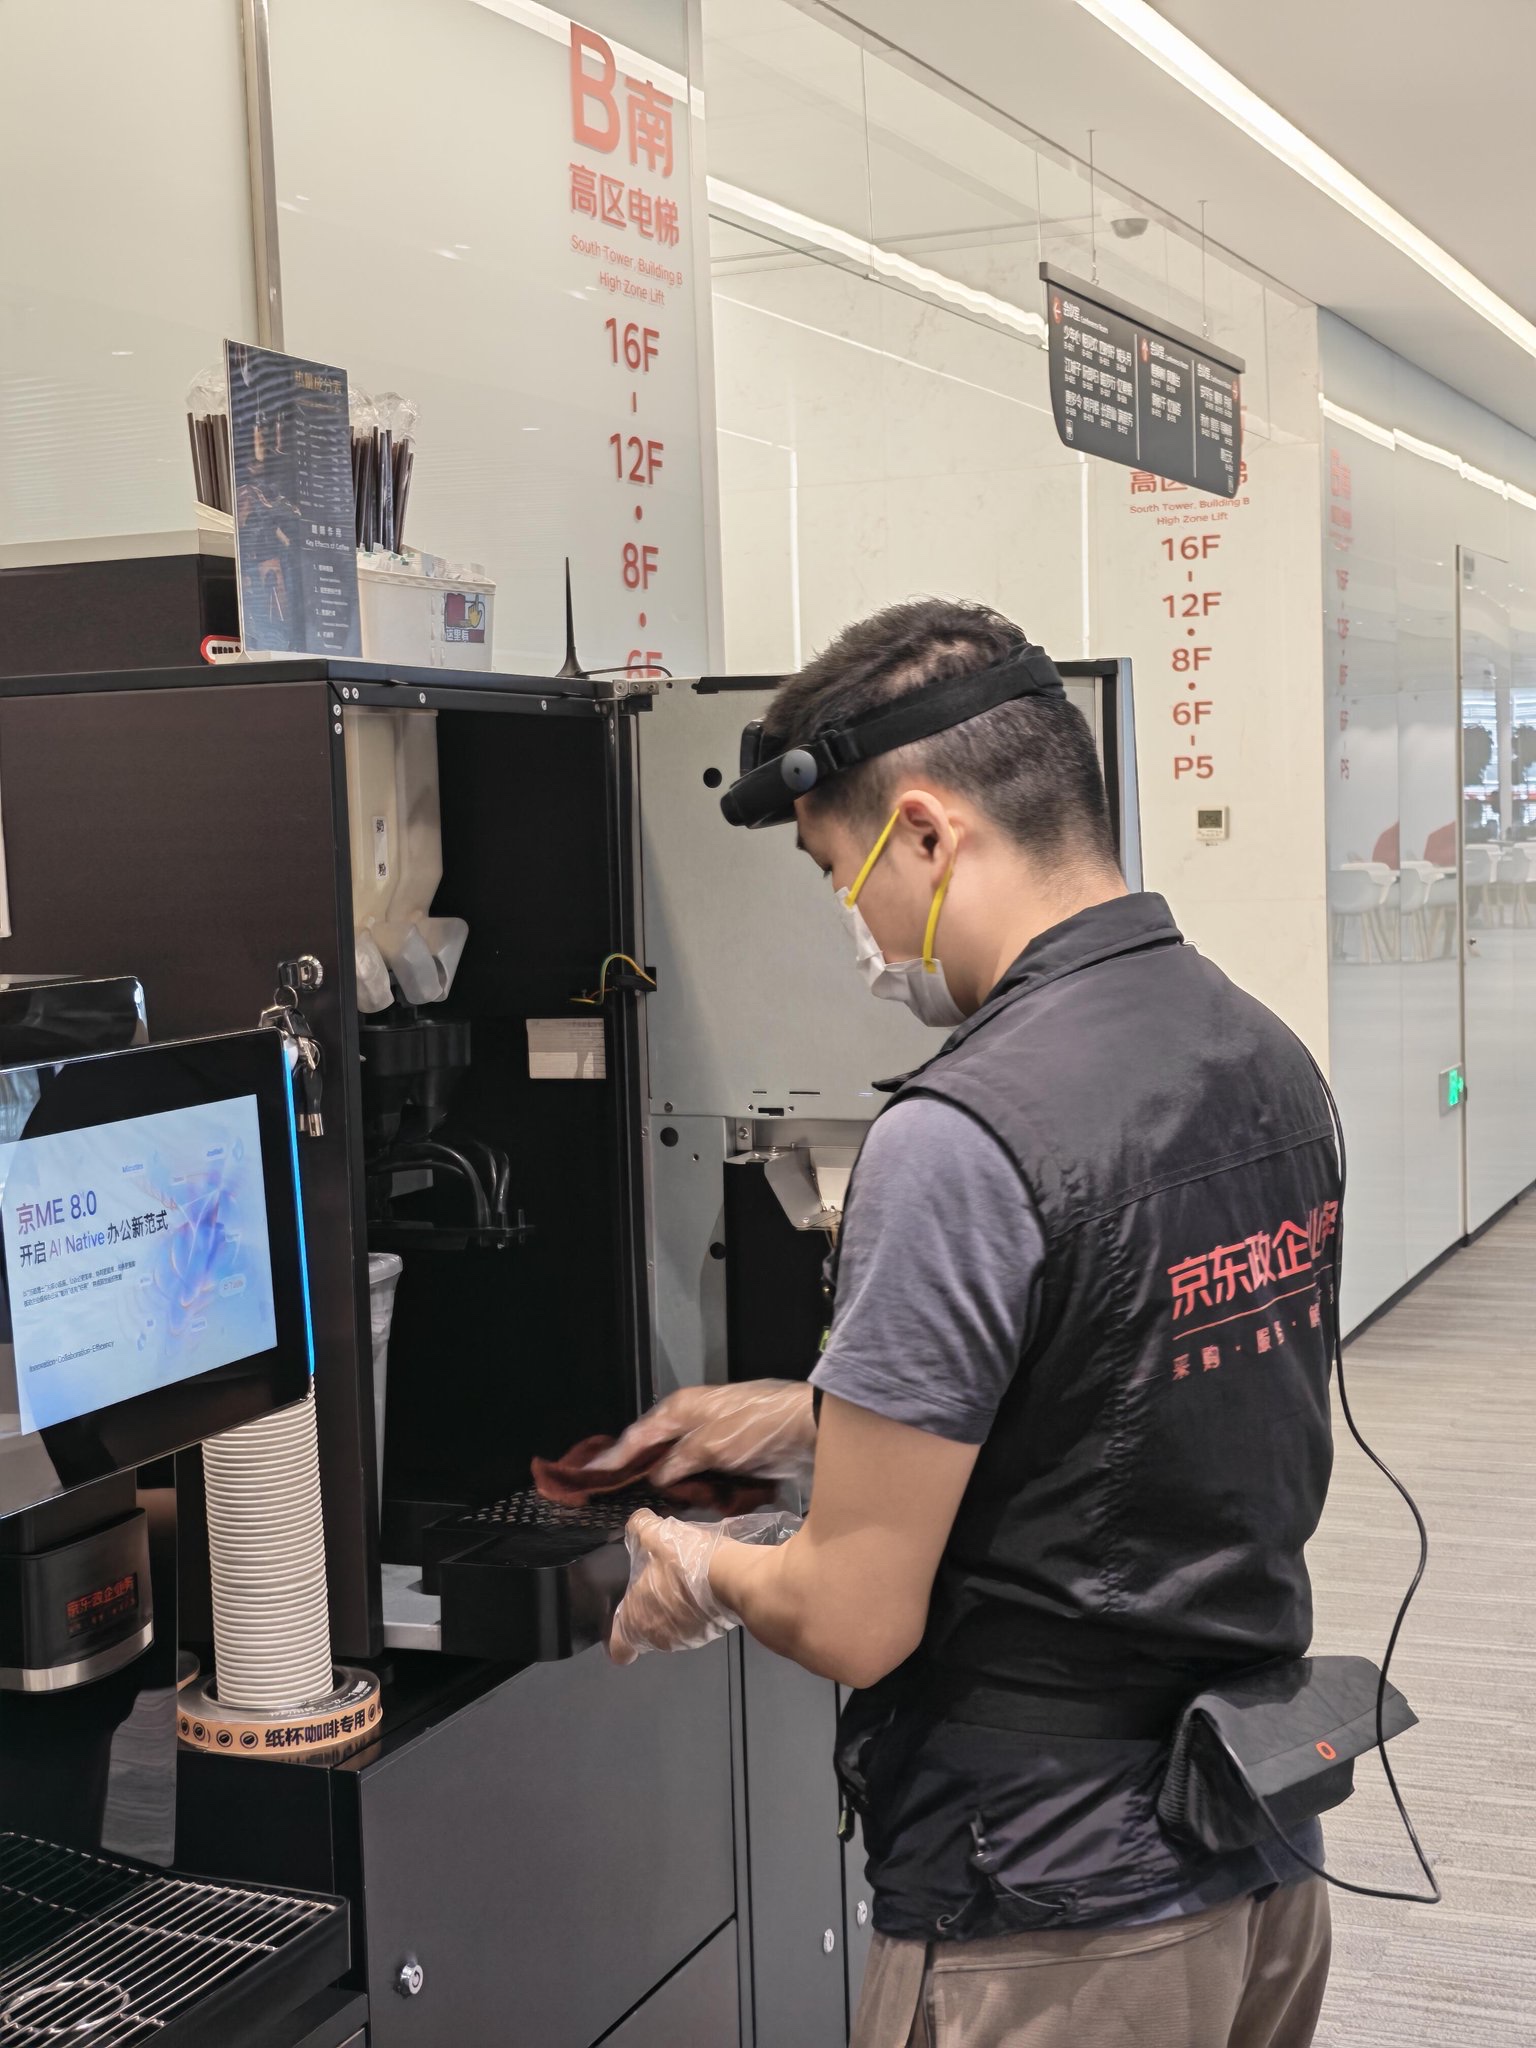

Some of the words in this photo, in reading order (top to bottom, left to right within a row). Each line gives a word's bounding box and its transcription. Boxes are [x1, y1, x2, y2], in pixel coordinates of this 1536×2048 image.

[569, 162, 680, 247] 高区电梯
[571, 234, 600, 256] South
[638, 258, 675, 286] Building
[677, 272, 683, 285] B
[599, 271, 621, 292] High
[624, 280, 648, 299] Zone
[650, 288, 665, 305] Lift
[605, 317, 660, 372] 16F
[609, 433, 664, 485] 12F
[1130, 504, 1159, 513] South
[1199, 498, 1240, 508] Building
[1157, 516, 1180, 526] High
[1183, 514, 1208, 523] Zone
[1211, 512, 1228, 521] Lift
[622, 542, 659, 590] 8F
[1161, 535, 1221, 561] 16F
[1162, 592, 1222, 618] 12F
[1171, 647, 1212, 672] 8F
[1172, 702, 1213, 726] 6F
[1174, 755, 1214, 780] P5
[16, 1198, 65, 1236] 京ME
[70, 1190, 97, 1220] 8.0
[19, 1240, 47, 1268] 开启
[49, 1239, 62, 1258] AI
[65, 1230, 105, 1255] Native
[107, 1210, 168, 1245] 办公新范式
[265, 1708, 366, 1748] 纸杯咖啡专用
